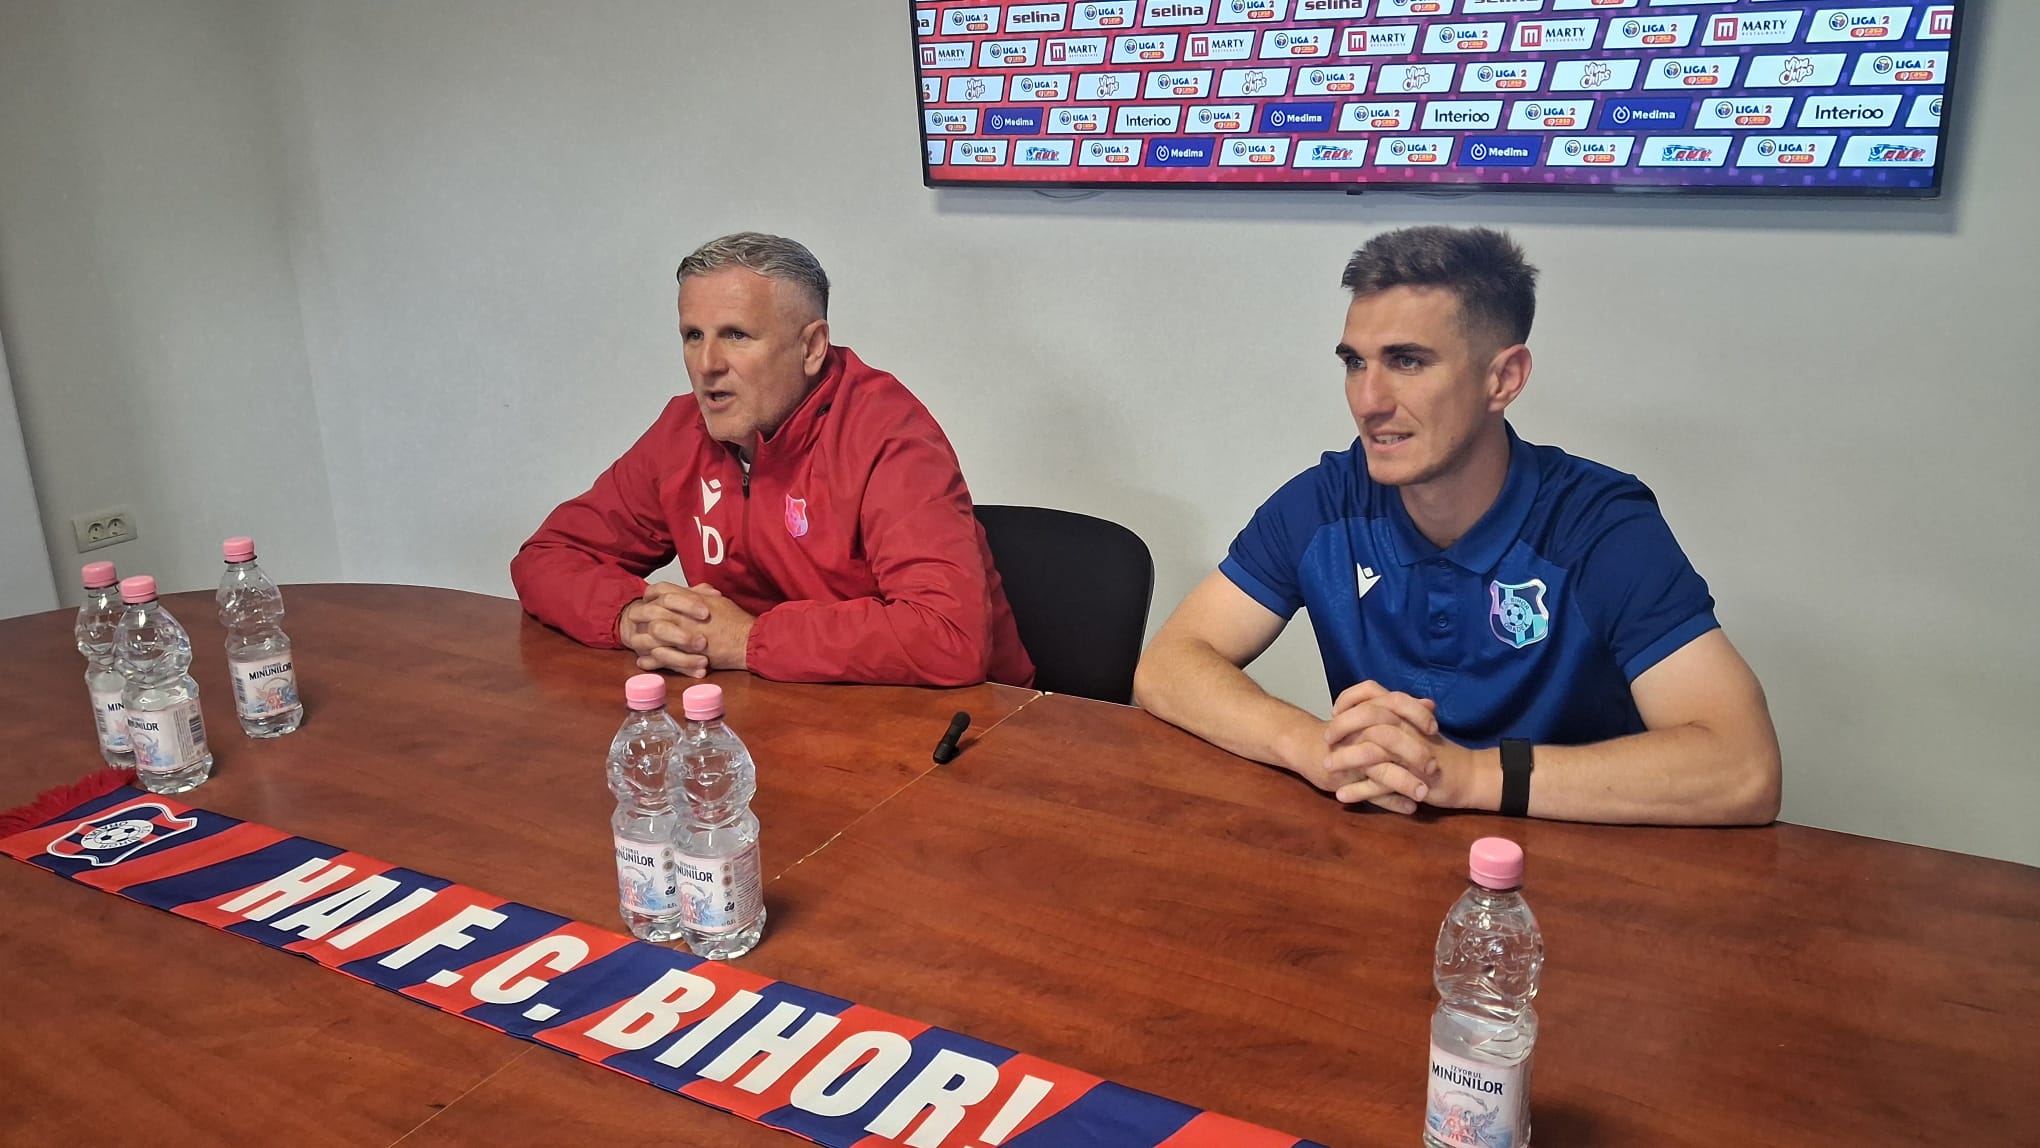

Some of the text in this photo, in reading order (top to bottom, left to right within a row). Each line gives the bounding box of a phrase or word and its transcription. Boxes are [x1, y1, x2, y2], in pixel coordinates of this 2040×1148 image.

[1305, 0, 1362, 10] selina
[1098, 8, 1115, 16] LIGA
[1151, 5, 1204, 17] selina
[1012, 11, 1060, 23] selina
[1851, 16, 1890, 25] LIGA 2
[1642, 24, 1677, 32] LIGA 2
[1741, 20, 1787, 30] MARTY
[1457, 31, 1477, 39] LIGA
[1545, 27, 1585, 37] MARTY
[1290, 36, 1309, 44] LIGA
[1370, 33, 1406, 43] MARTY
[1139, 42, 1155, 50] LIGA
[1212, 39, 1244, 48] MARTY
[938, 49, 965, 58] MARTY
[1068, 45, 1098, 54] MARTY
[1683, 65, 1719, 73] LIGA 2
[1895, 60, 1935, 69] LIGA 2
[1495, 69, 1527, 77] LIGA 2
[1394, 109, 1400, 117] 2
[1543, 107, 1575, 116] LIGA 2
[1632, 110, 1675, 119] Medima
[1735, 105, 1772, 115] LIGA 2
[1816, 105, 1883, 120] Interioo
[1213, 112, 1231, 120] LIGA
[1287, 113, 1322, 122] Medima
[1435, 108, 1489, 123] Interioo
[1004, 117, 1034, 126] Medima
[1126, 114, 1171, 127] Interioo
[1583, 144, 1616, 152] LIGA 2
[1779, 143, 1815, 152] LIGA 2
[1171, 149, 1203, 158] Medima
[1488, 148, 1528, 157] Medima
[249, 662, 292, 681] MINUNILOR
[218, 857, 1055, 1148] HAI F.C. BIHOR!
[1450, 1064, 1482, 1079] IZVORUL
[1432, 1061, 1503, 1096] MINUNILOR
